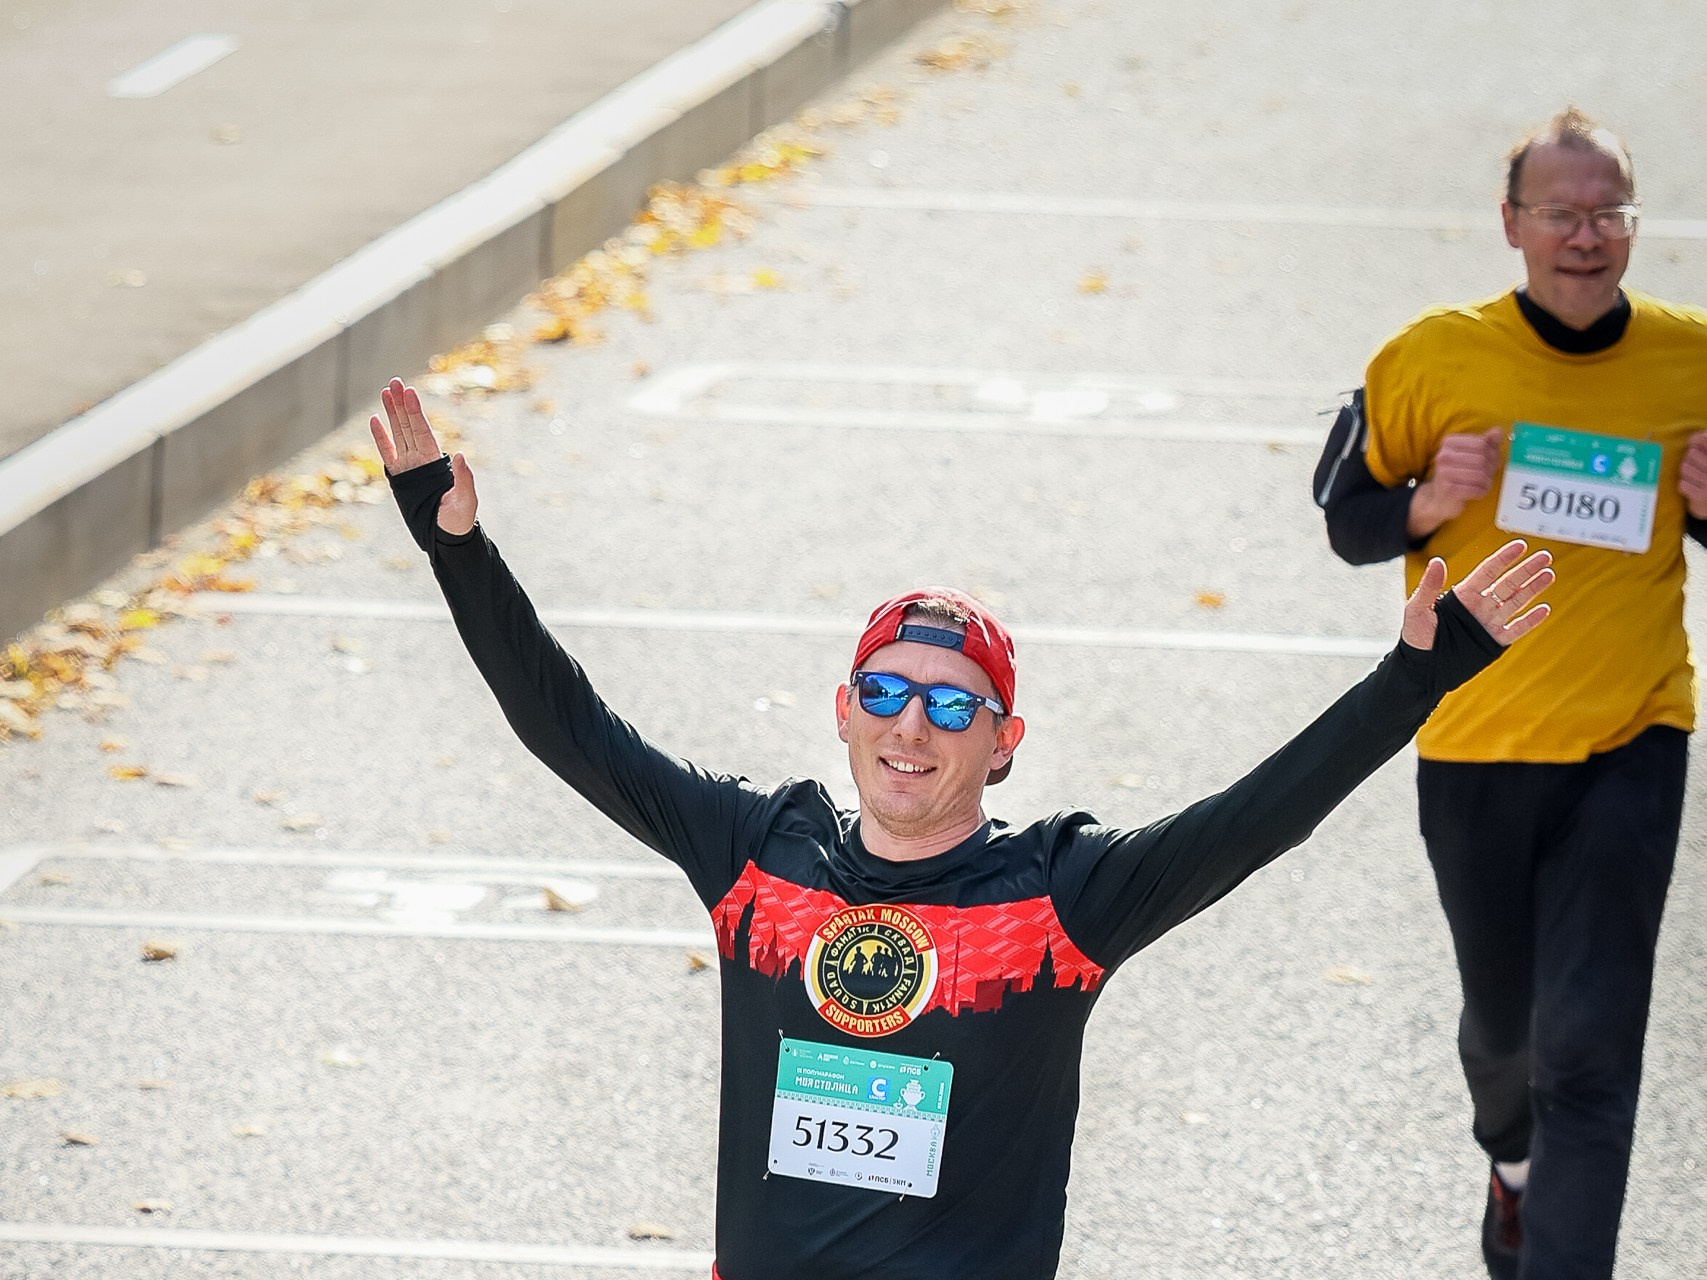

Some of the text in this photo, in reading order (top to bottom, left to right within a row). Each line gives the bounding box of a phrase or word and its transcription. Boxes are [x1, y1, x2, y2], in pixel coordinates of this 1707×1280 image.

[1516, 482, 1621, 524] 50180
[822, 908, 930, 949] SPARTAK MOSCOW
[884, 929, 915, 965] СКВАД
[826, 971, 858, 1009] SQUAD
[825, 1003, 904, 1033] SUPPORTERS
[803, 1068, 845, 1080] ПОЛУМАРАФОН
[814, 1079, 859, 1095] СТОЛИЦА
[792, 1115, 899, 1161] 51332
[926, 1141, 938, 1177] МОСКВА
